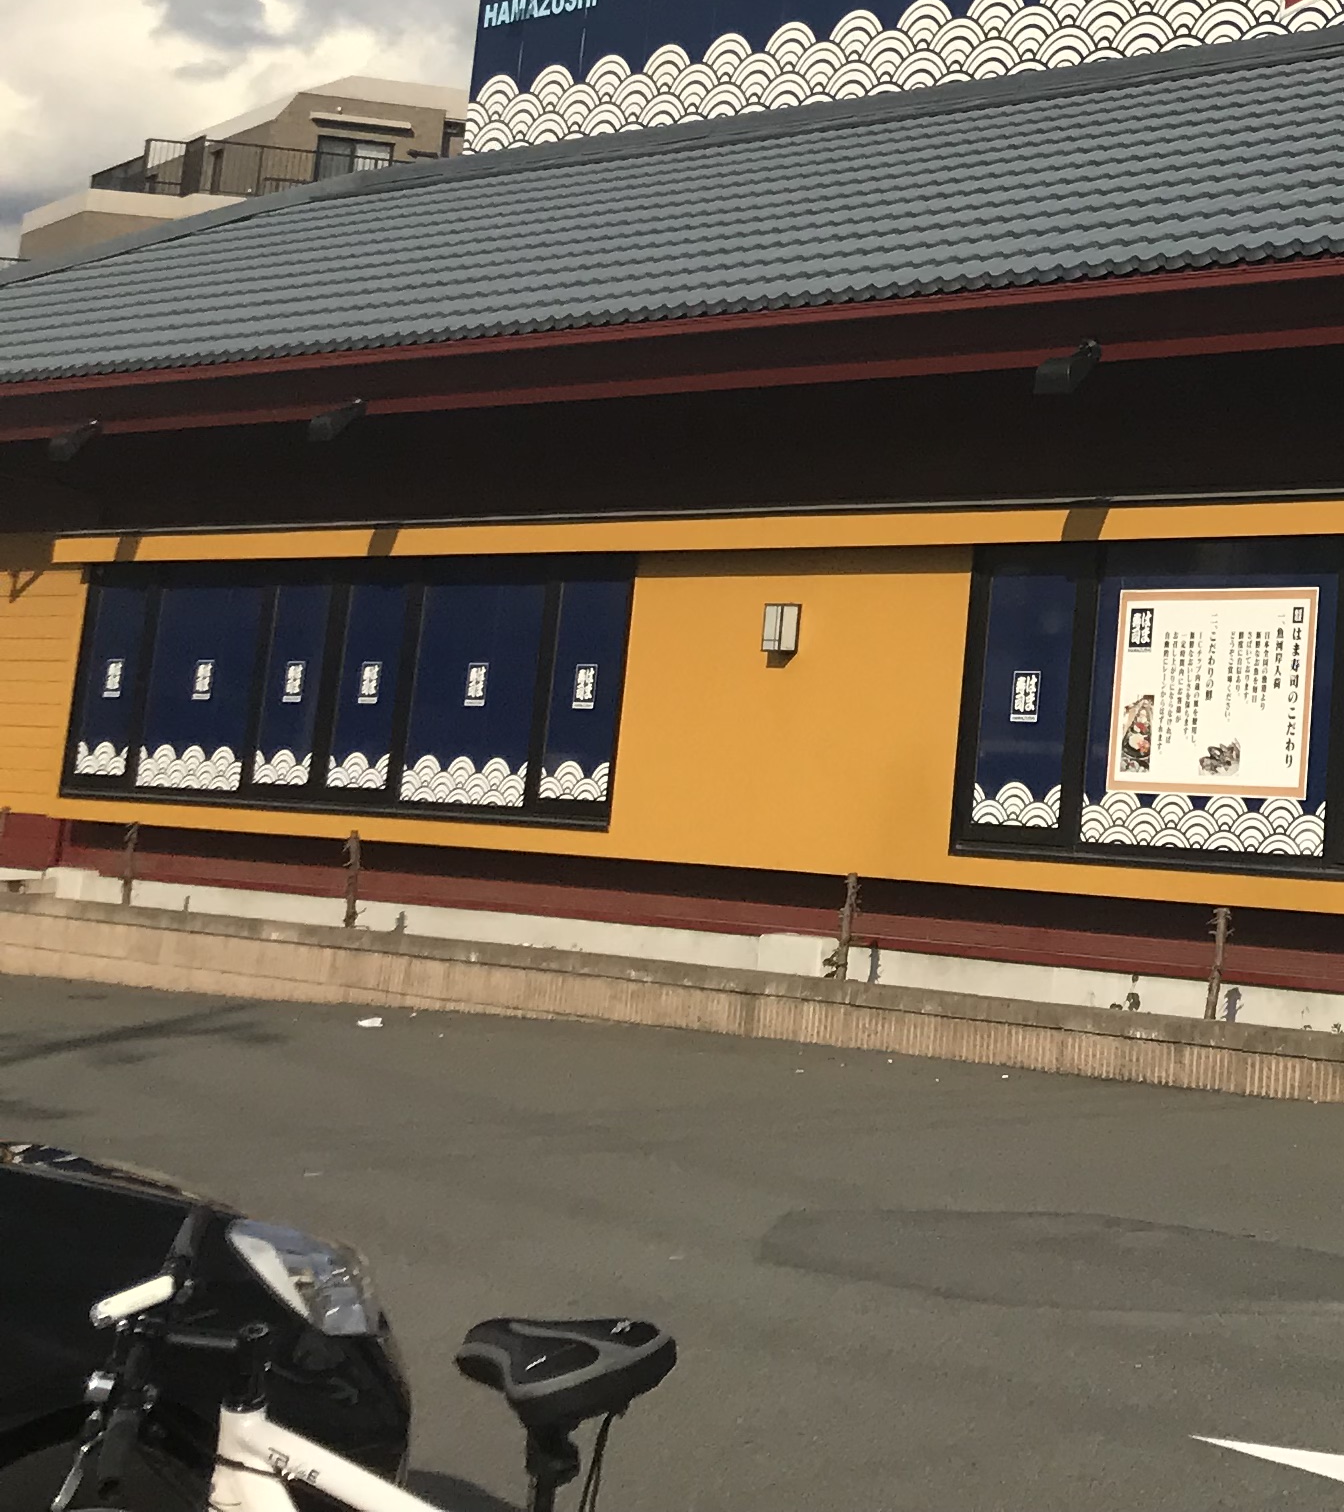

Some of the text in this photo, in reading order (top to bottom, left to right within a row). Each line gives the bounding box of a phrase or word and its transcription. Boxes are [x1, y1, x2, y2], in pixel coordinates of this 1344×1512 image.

[1285, 627, 1302, 768] はま寿司のこだわり
